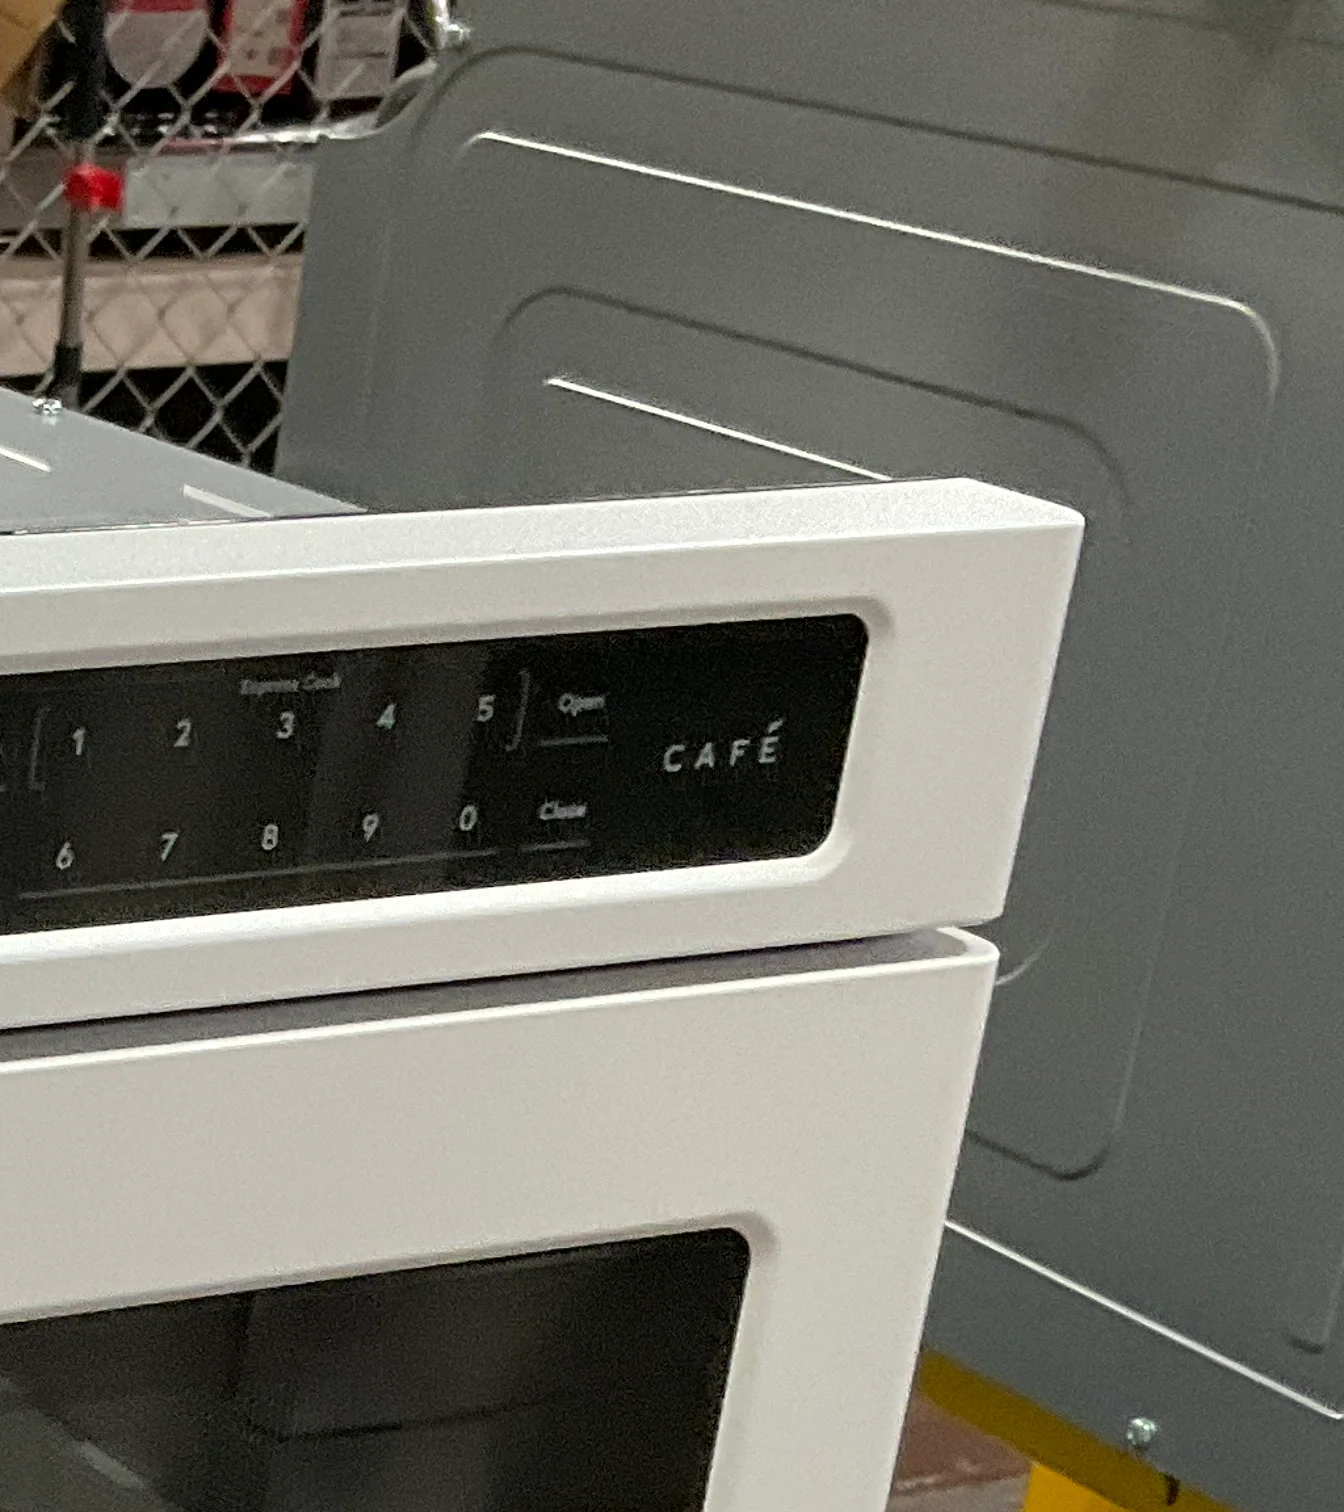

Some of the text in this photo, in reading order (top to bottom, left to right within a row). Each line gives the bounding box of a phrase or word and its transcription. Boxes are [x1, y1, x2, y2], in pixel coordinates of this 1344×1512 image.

[72, 694, 495, 756] 1 2 3 4 5
[662, 718, 784, 773] CAFÉ
[55, 804, 478, 870] 6 7 8 9 0
